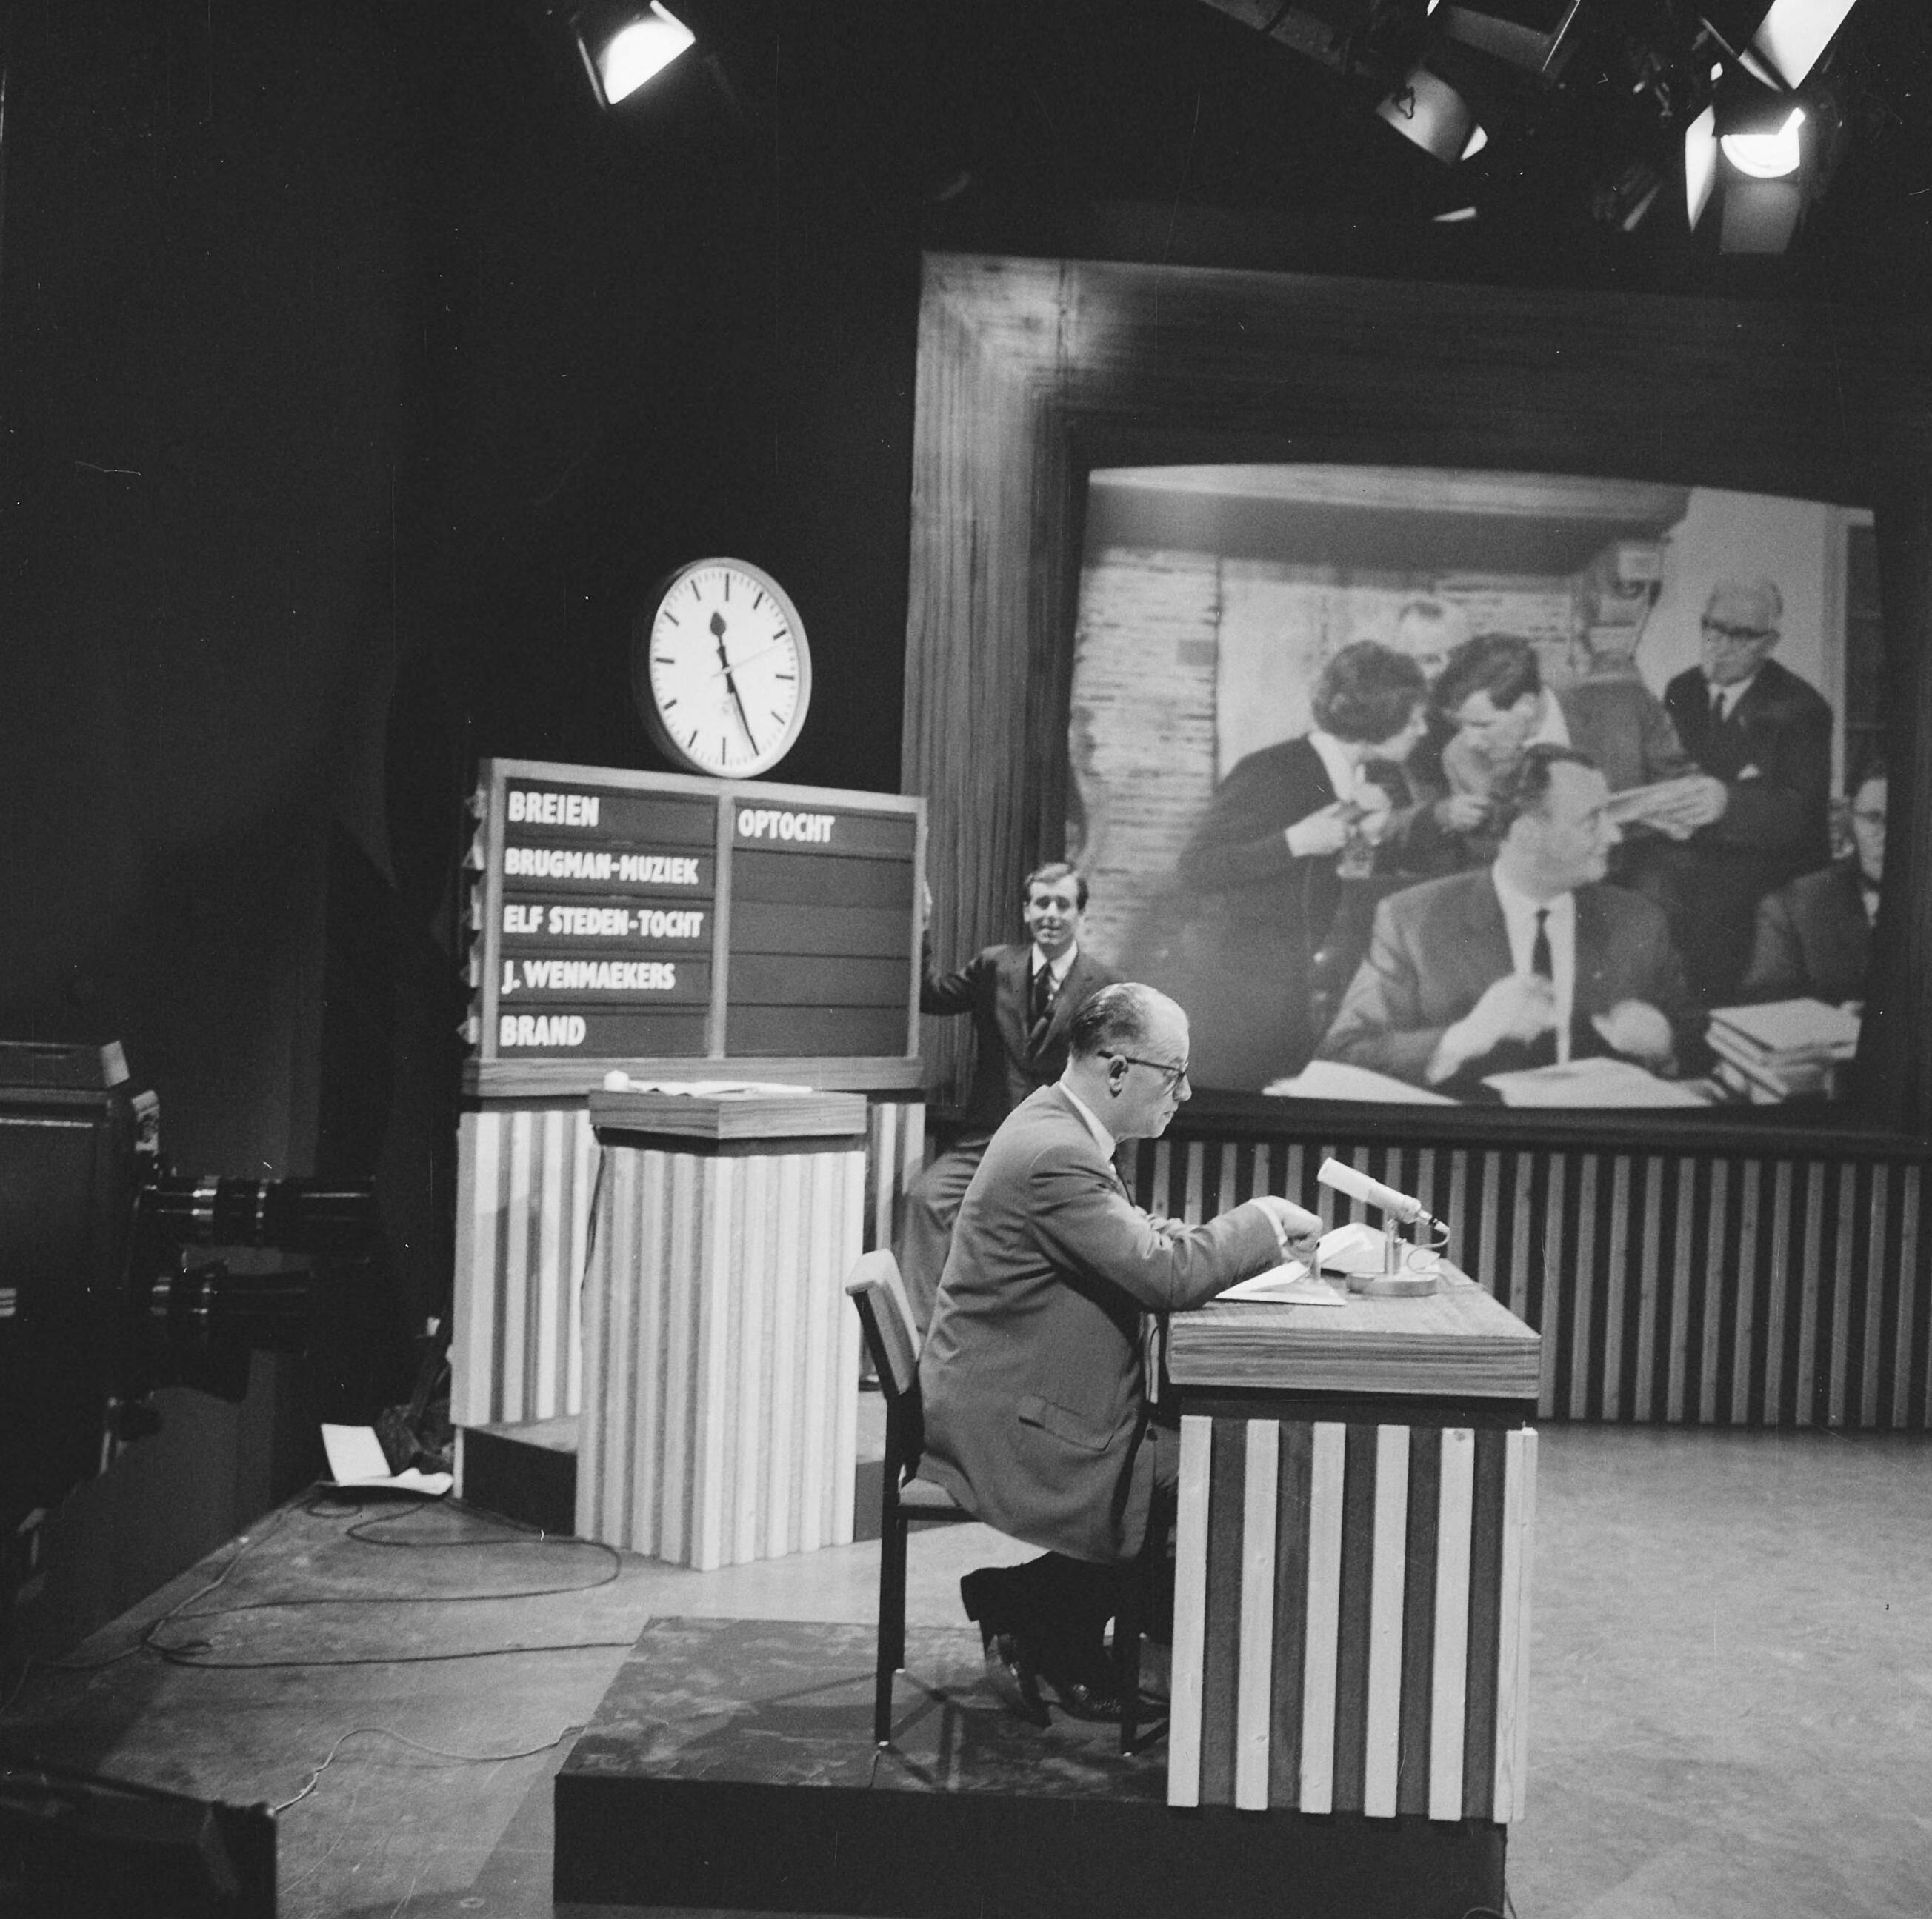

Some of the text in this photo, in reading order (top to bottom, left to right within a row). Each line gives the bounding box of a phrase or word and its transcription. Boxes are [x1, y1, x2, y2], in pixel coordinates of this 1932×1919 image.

[508, 790, 599, 827] BREIEN
[737, 809, 836, 843] OPTOCHT
[504, 847, 699, 885] BRUGMAN-MUZIEK
[503, 904, 704, 938] ELF STEDEN-TOCHT
[501, 960, 676, 995] J. WENMAEKERS
[499, 1015, 587, 1047] BRAND
